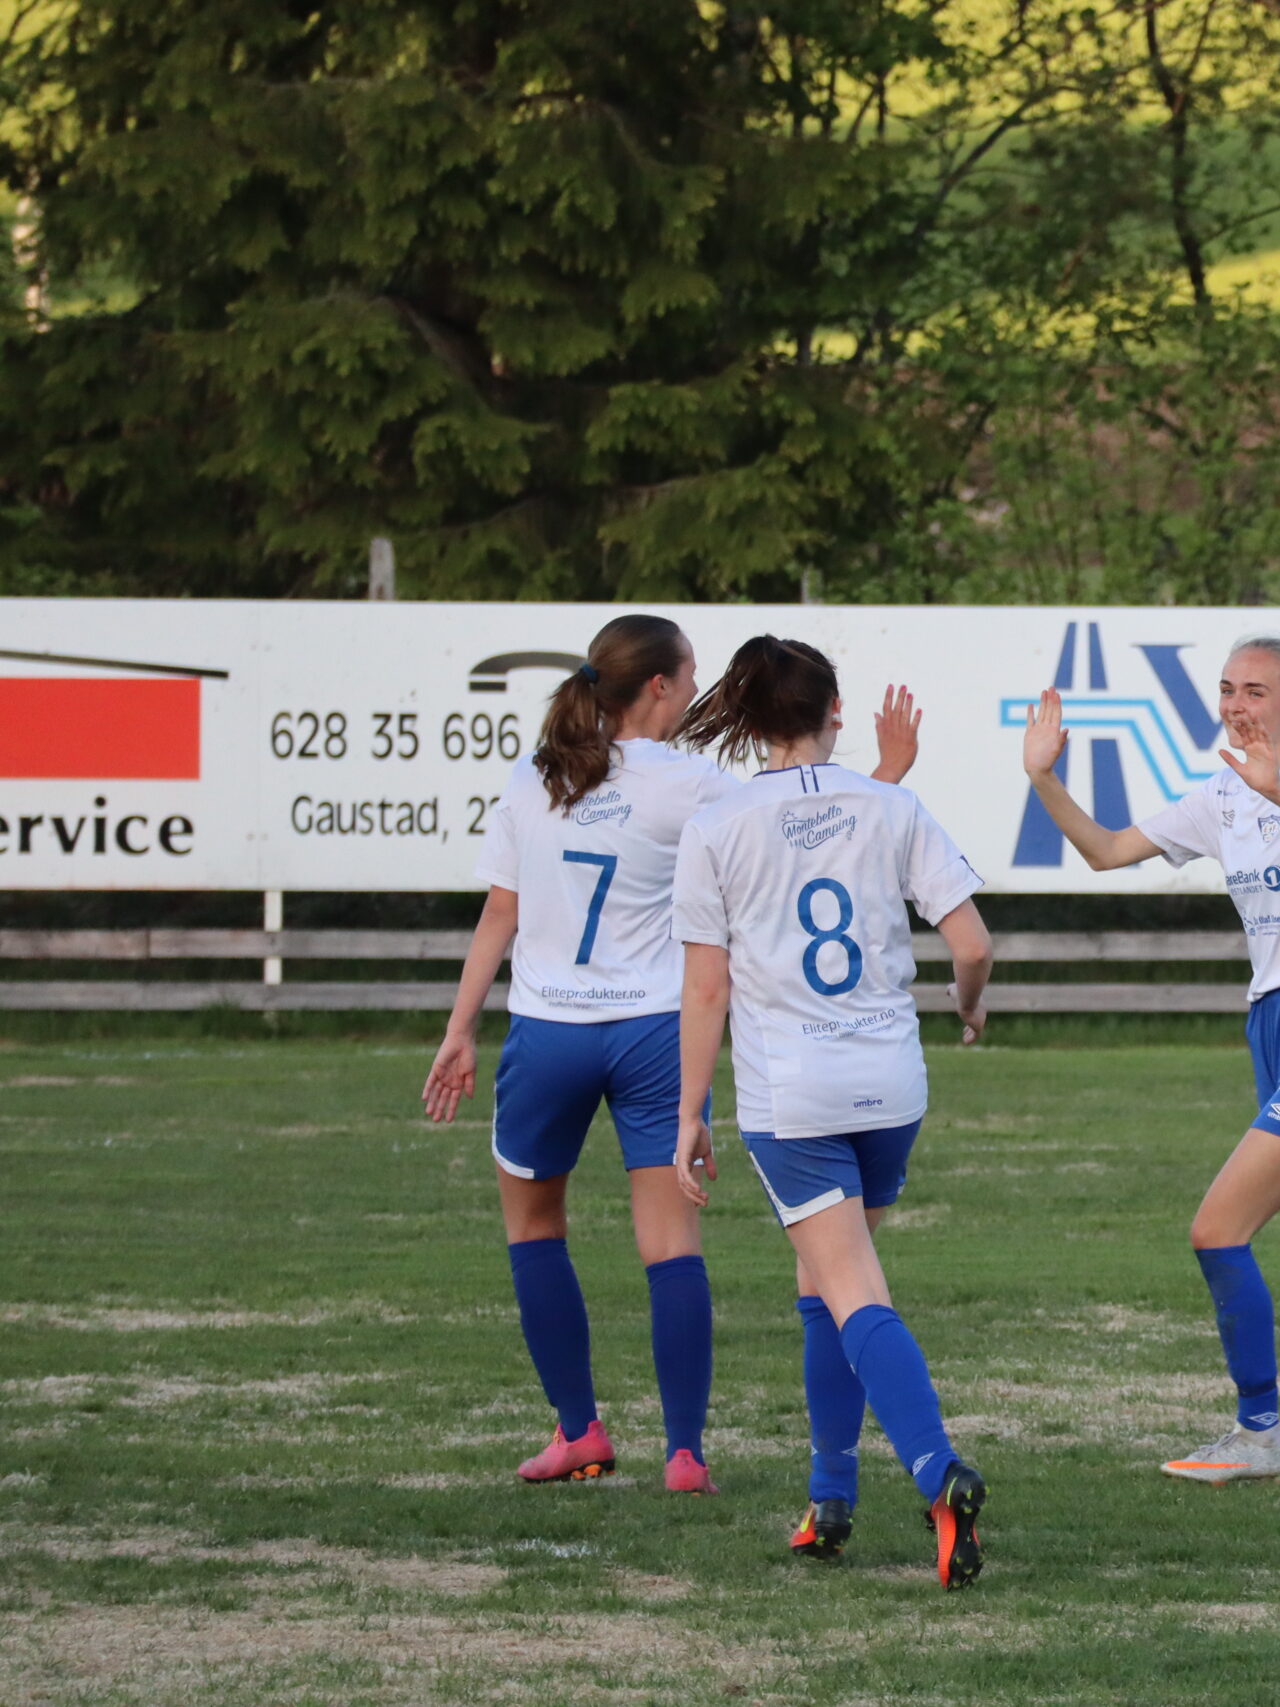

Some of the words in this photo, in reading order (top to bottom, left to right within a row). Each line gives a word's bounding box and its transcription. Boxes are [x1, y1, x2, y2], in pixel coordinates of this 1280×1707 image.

[271, 712, 348, 760] 628
[371, 713, 420, 760] 35
[443, 713, 522, 761] 696
[561, 790, 621, 811] ontebello
[581, 803, 632, 821] Camping
[0, 795, 194, 856] rvice
[291, 796, 450, 844] Gaustad,
[466, 796, 501, 834] 2
[785, 804, 843, 840] Montebello
[806, 815, 857, 845] Camping
[562, 850, 618, 965] 7
[797, 877, 863, 997] 8
[541, 986, 646, 1000] Eliteprodukter.no
[853, 1099, 883, 1108] umbro
